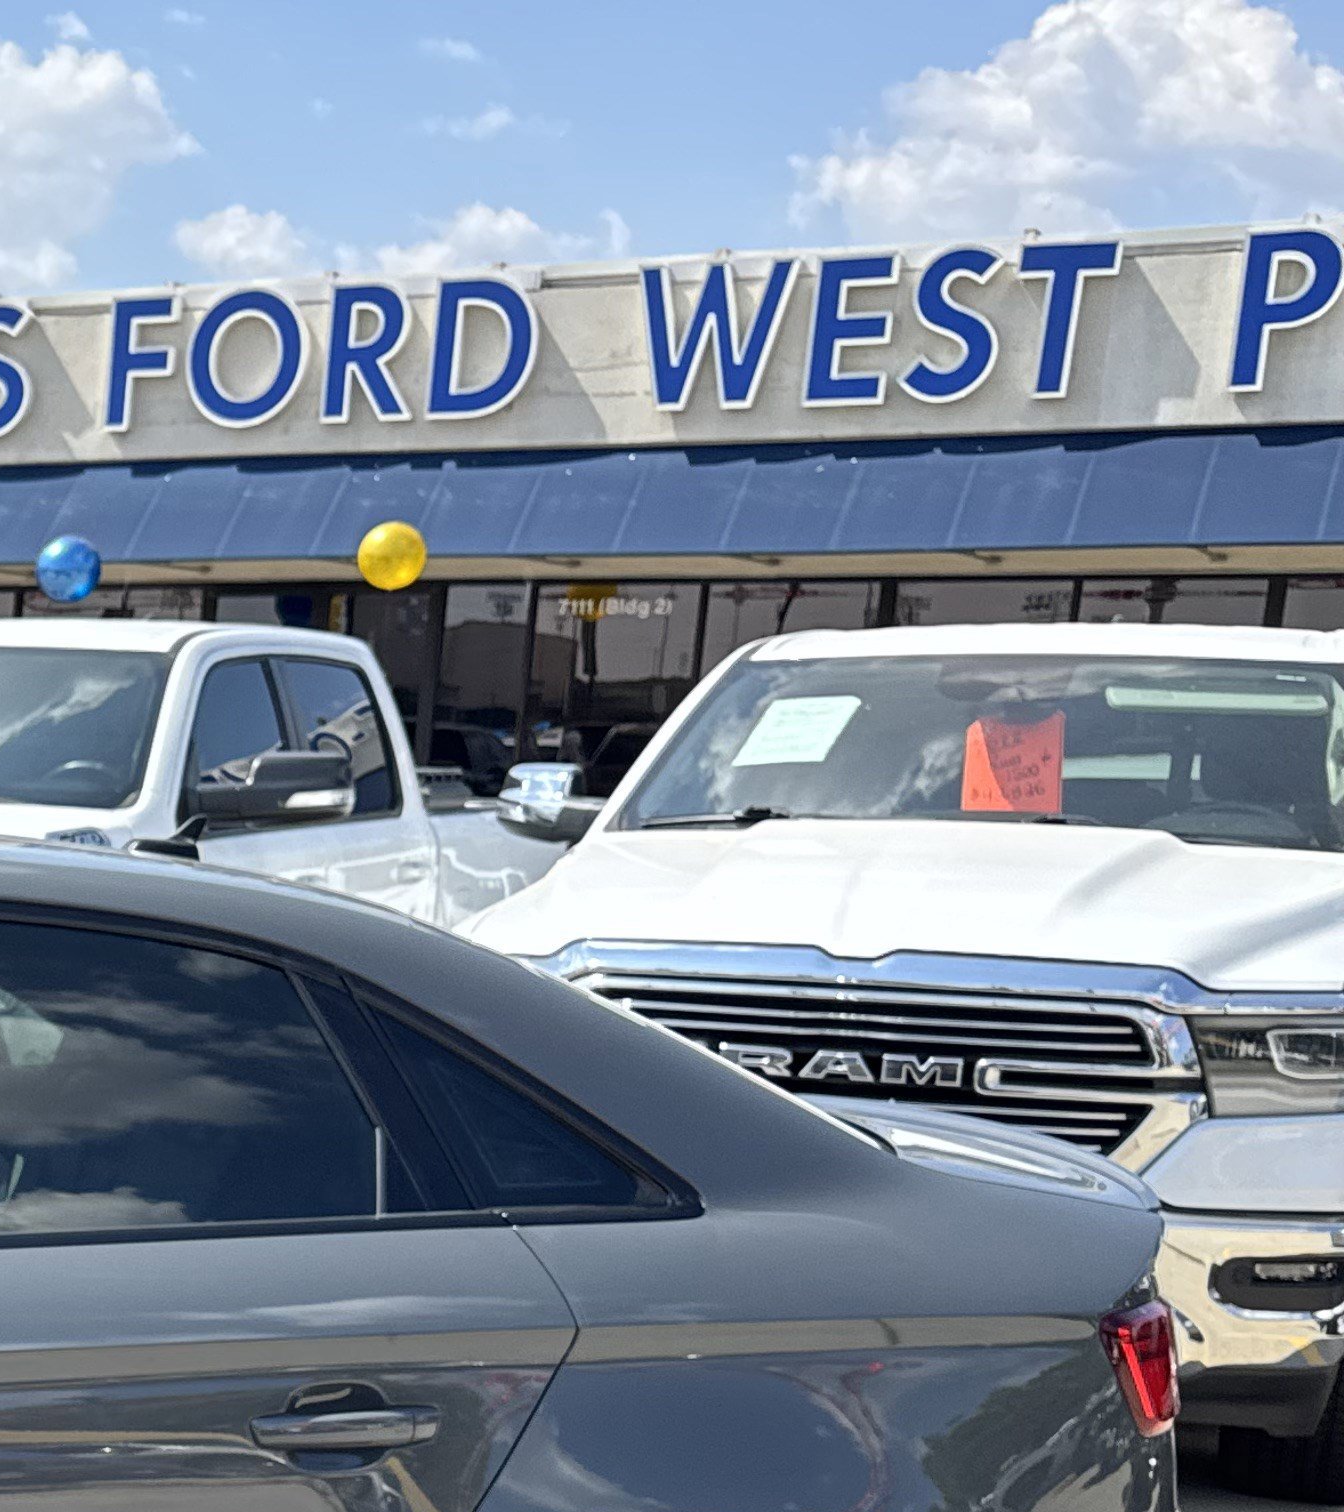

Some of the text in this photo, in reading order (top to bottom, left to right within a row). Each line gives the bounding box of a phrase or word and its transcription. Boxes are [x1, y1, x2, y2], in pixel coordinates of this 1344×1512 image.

[102, 277, 538, 433] FORD
[641, 240, 1123, 410] WEST
[1228, 229, 1344, 392] P
[718, 1041, 964, 1088] RAM
